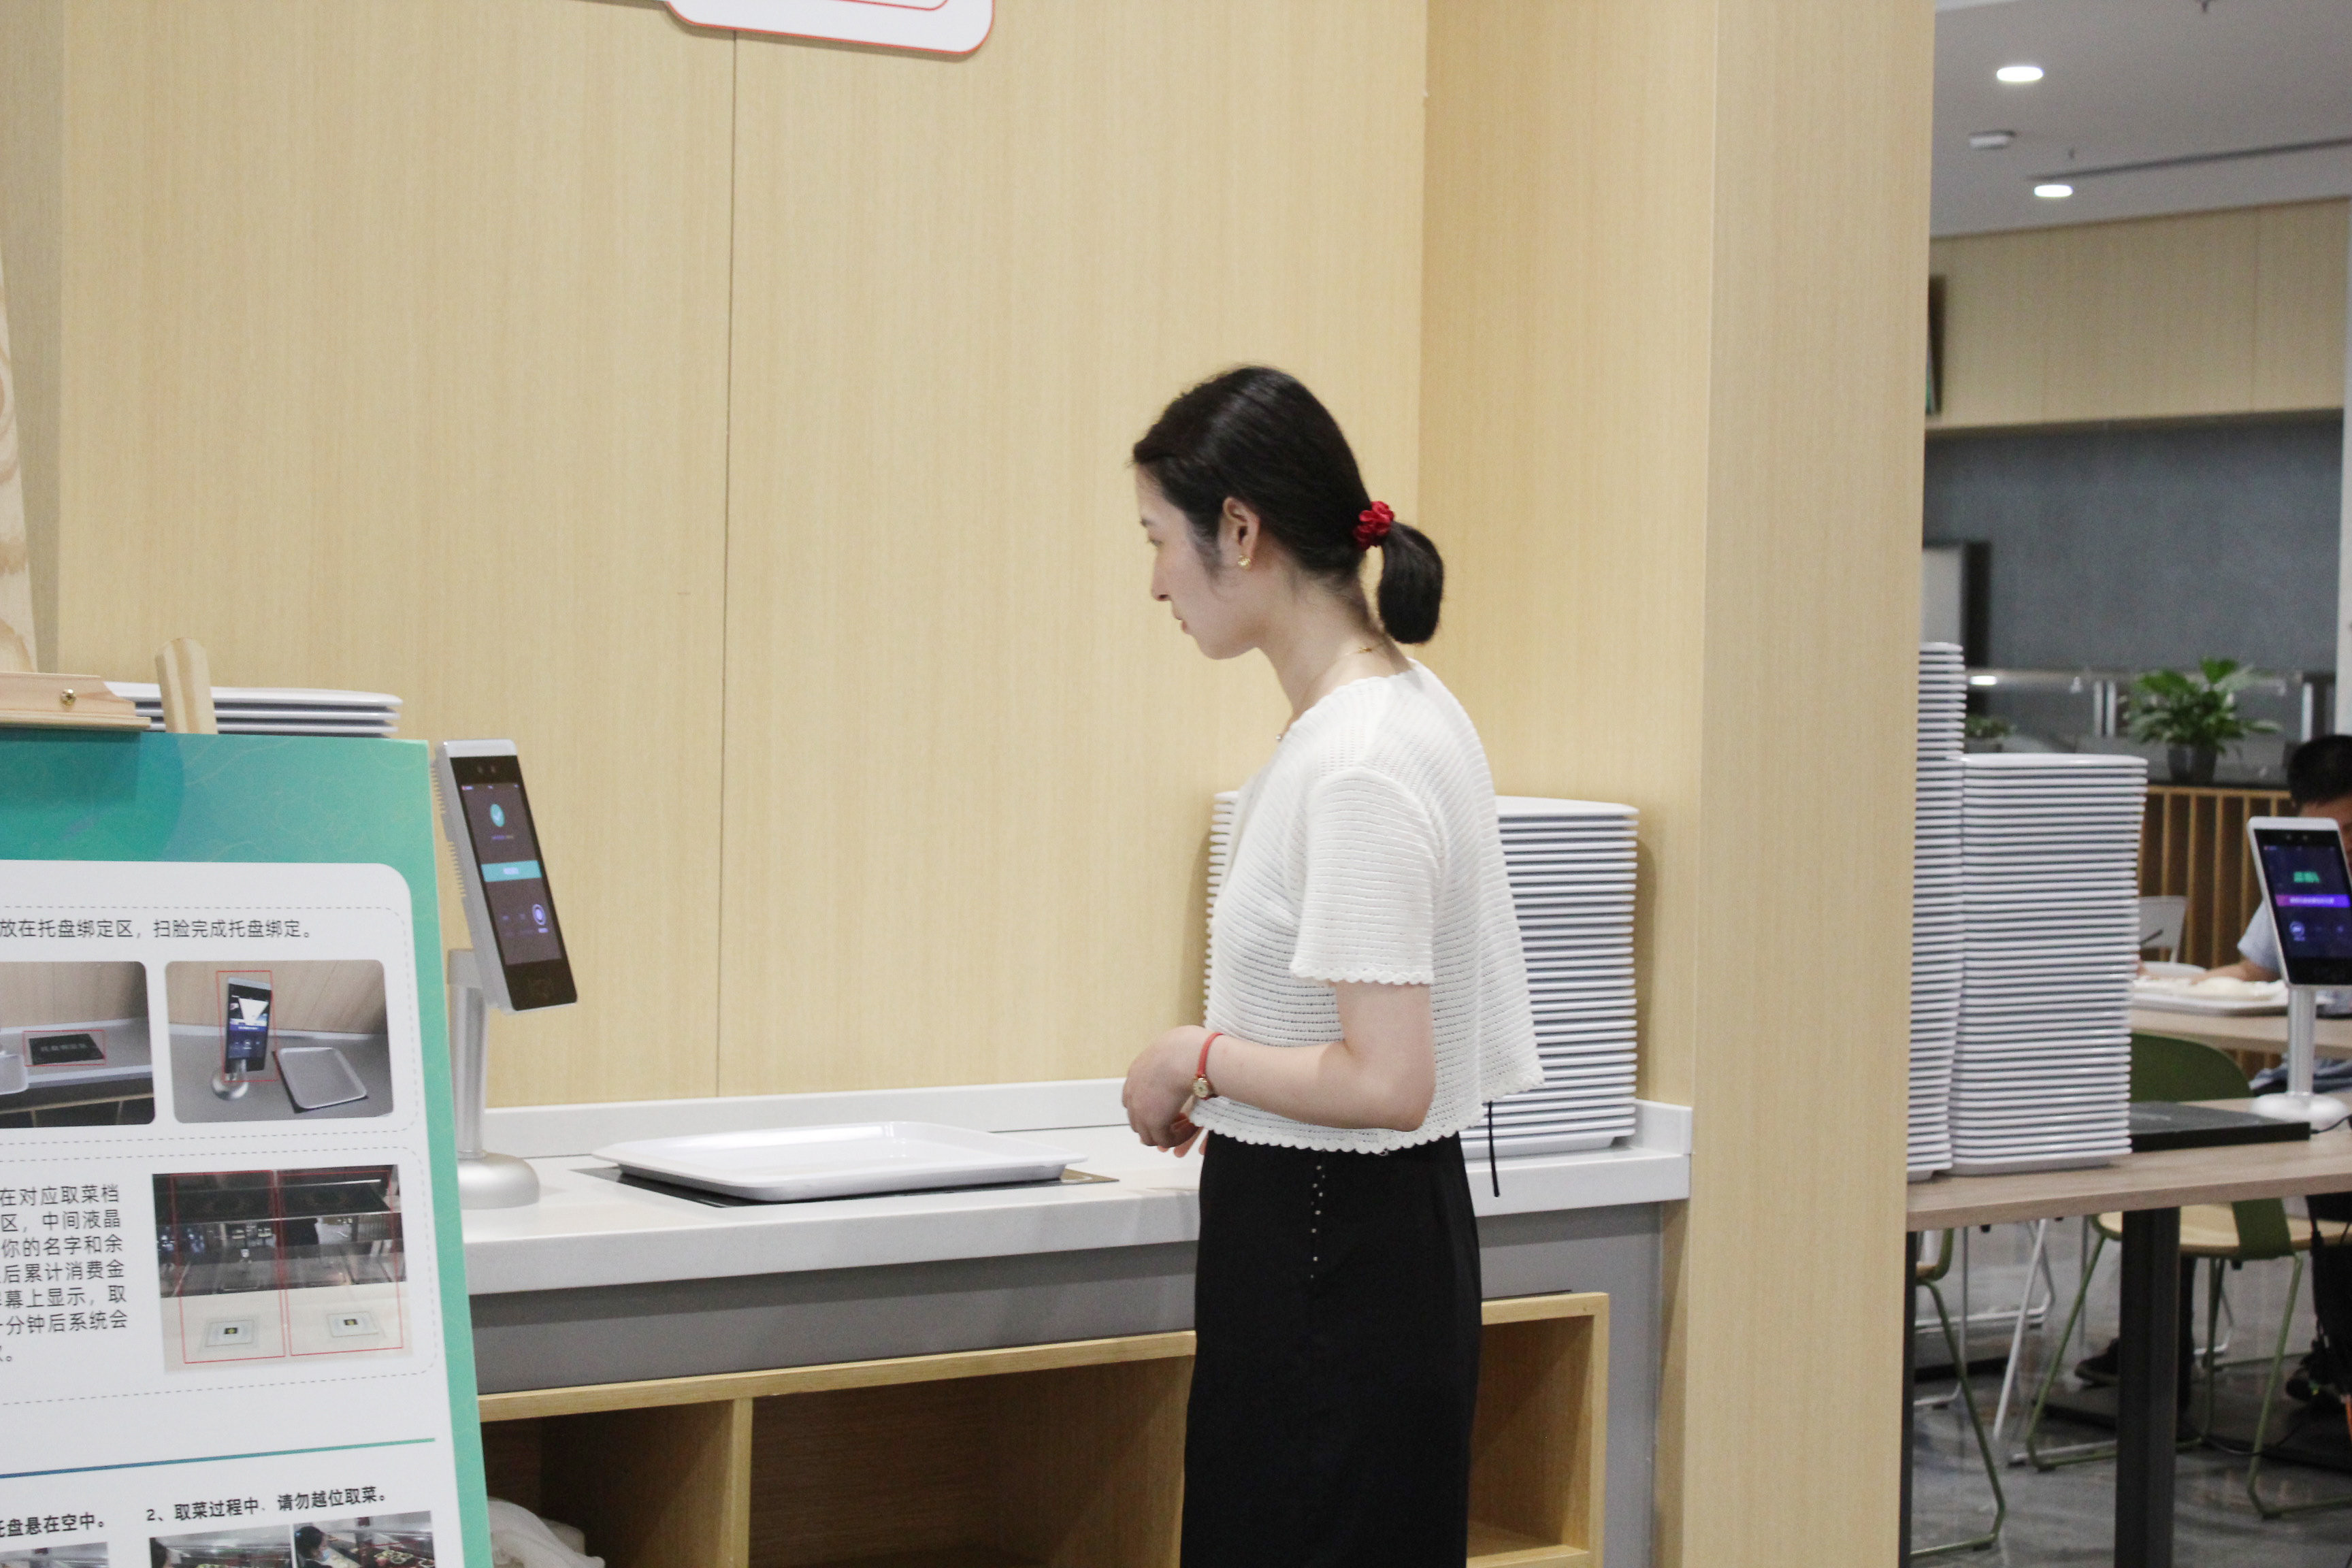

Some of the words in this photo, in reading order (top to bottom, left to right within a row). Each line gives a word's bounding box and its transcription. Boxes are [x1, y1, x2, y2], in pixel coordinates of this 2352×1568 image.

[0, 1183, 119, 1206] 在对应取菜档
[1, 1233, 123, 1258] 你的名字和余
[0, 1259, 125, 1284] 后累计消费金
[0, 1284, 127, 1309] 幕上显示，取
[0, 1309, 128, 1335] 分钟后系统会
